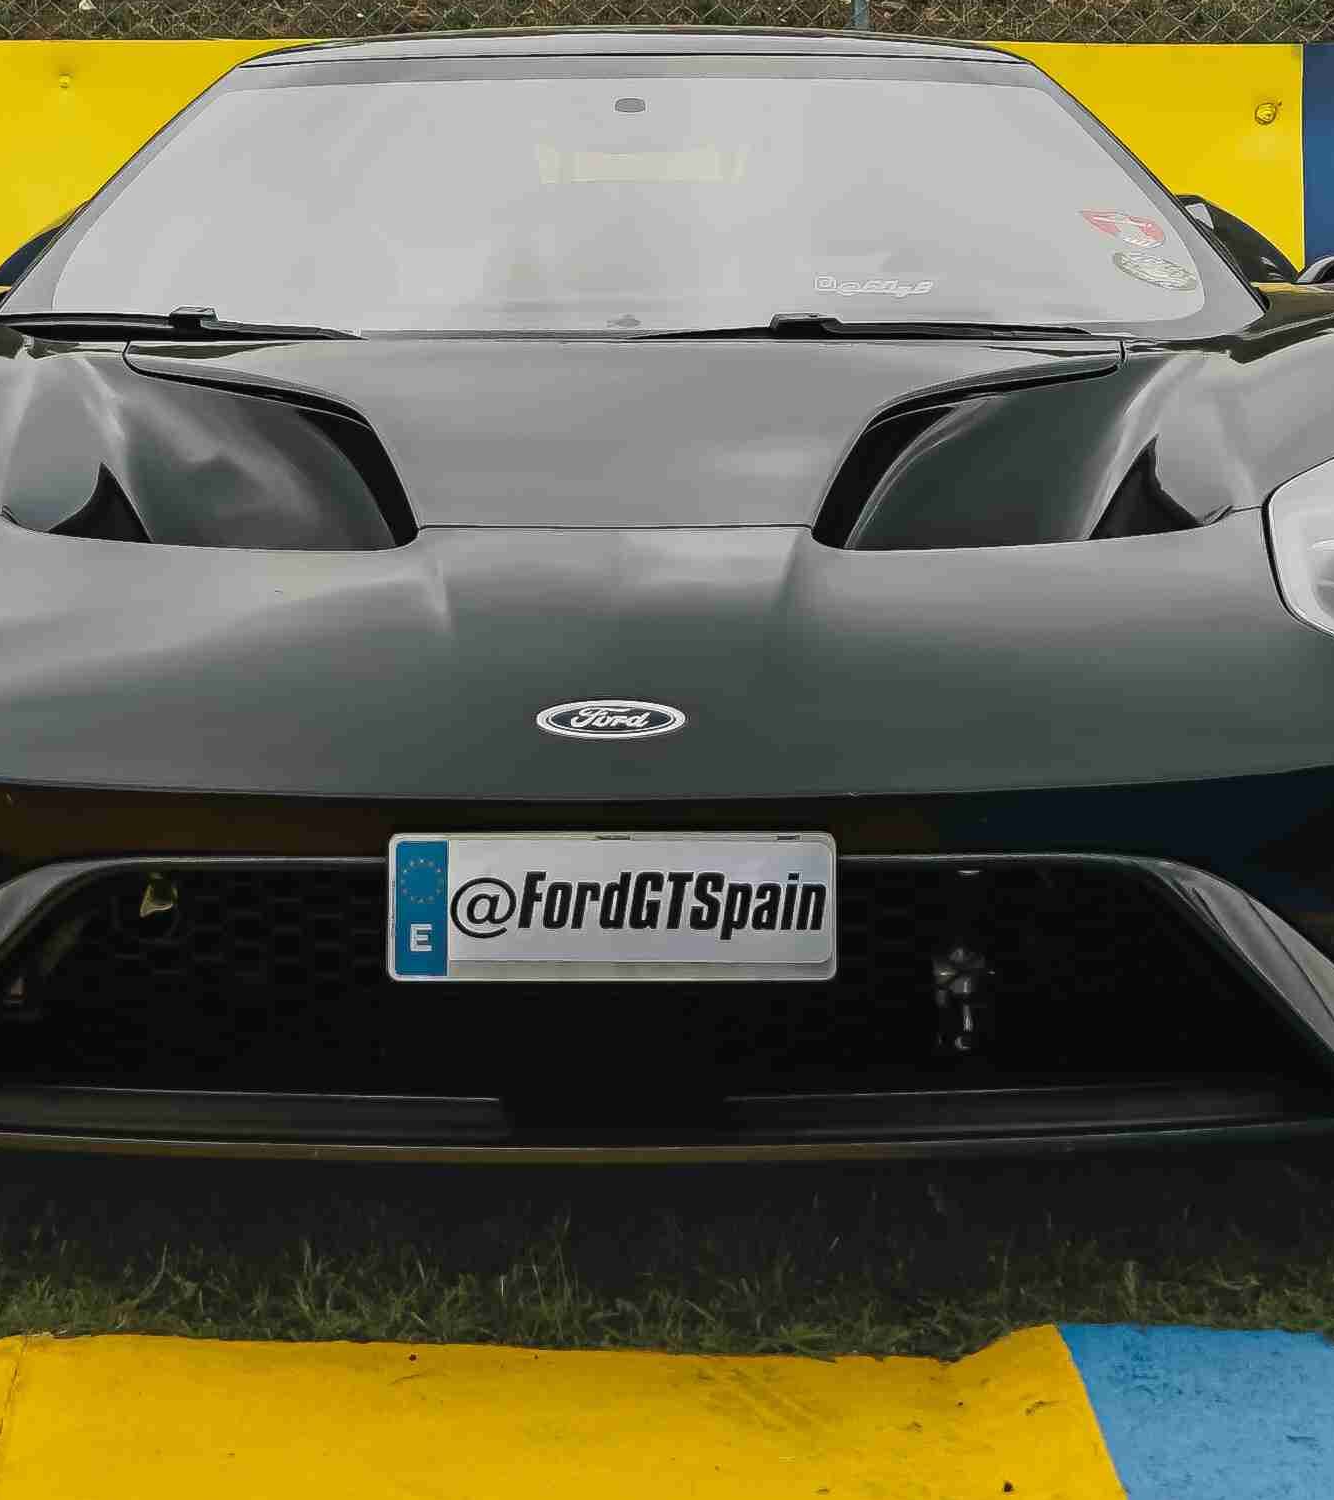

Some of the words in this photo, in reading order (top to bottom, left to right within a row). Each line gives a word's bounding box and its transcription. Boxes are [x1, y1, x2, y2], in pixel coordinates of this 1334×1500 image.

[570, 705, 650, 728] Ford
[409, 923, 433, 952] E
[450, 871, 828, 940] @FordGTSpain
